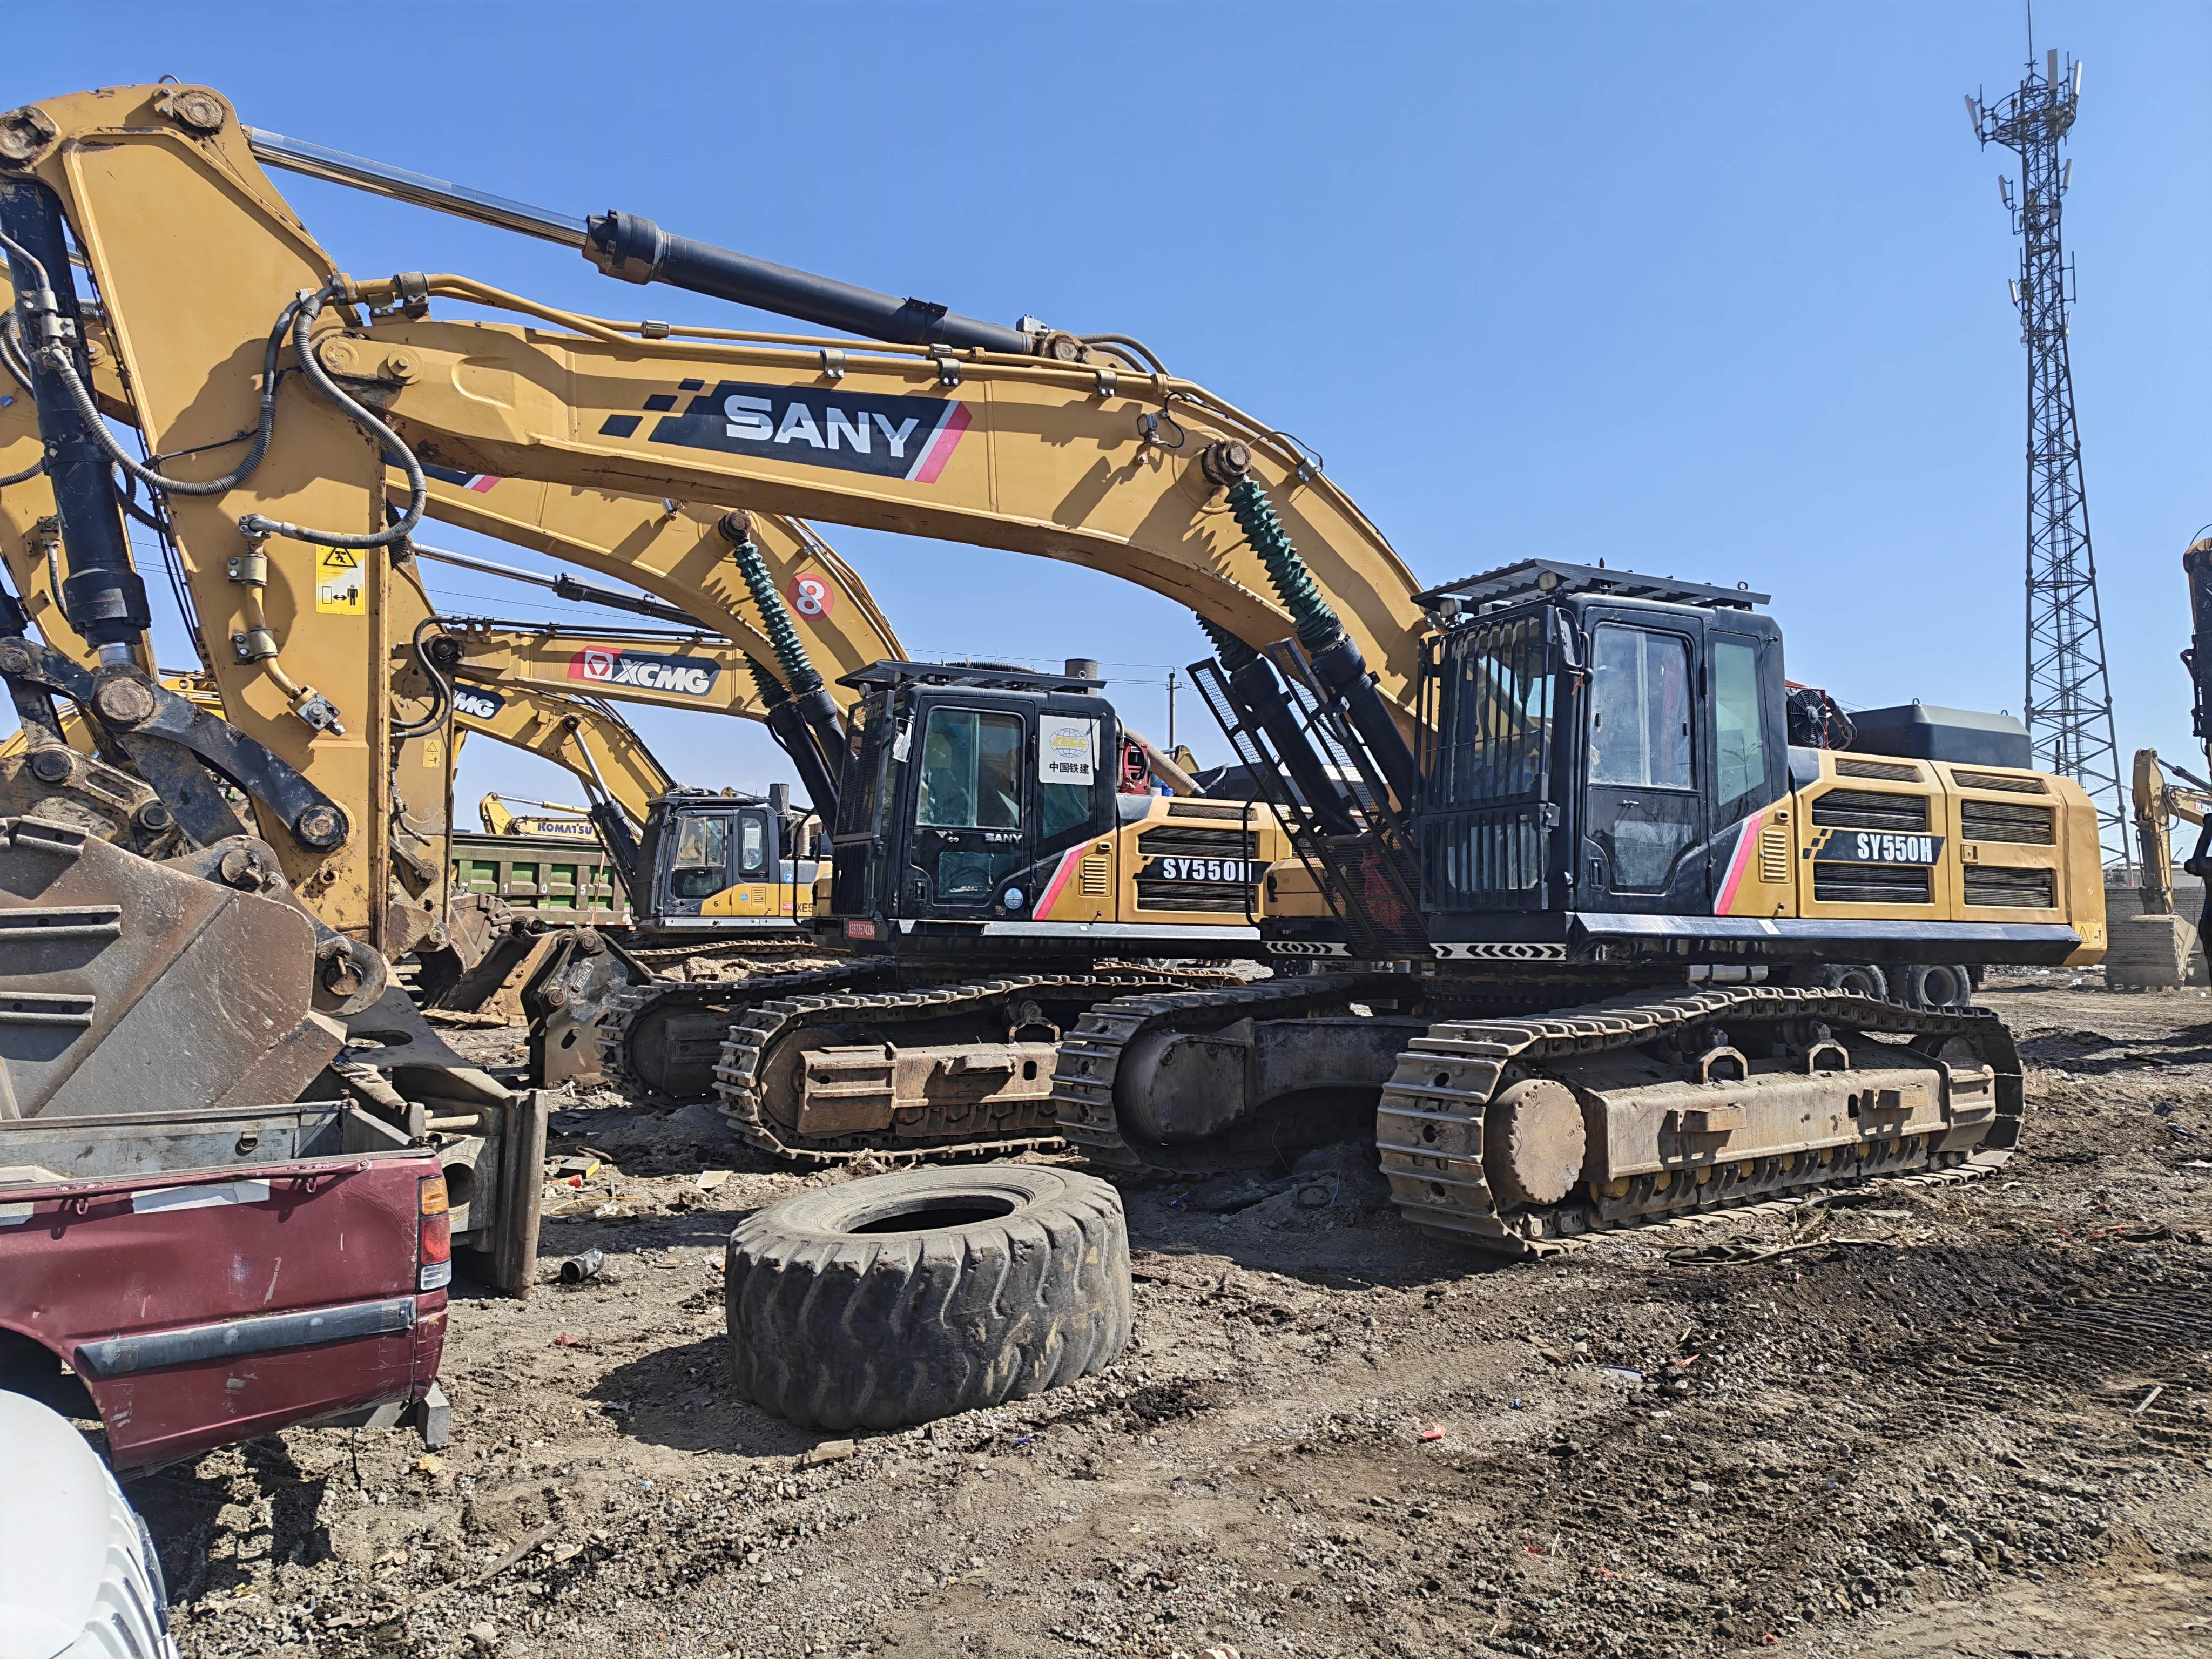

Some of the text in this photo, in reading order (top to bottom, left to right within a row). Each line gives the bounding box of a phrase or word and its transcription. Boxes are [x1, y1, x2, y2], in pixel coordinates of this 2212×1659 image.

[724, 395, 920, 458] SANY
[797, 580, 825, 615] 8
[611, 658, 710, 694] XCMG
[454, 690, 495, 718] MG
[1049, 761, 1090, 774] 中国铁建
[537, 822, 593, 835] KOMATSU
[984, 833, 1023, 844] SANY
[1857, 833, 1933, 862] SY550H
[787, 873, 792, 881] 2
[503, 882, 586, 896] 1 0 5
[576, 965, 591, 988] EDDIE
